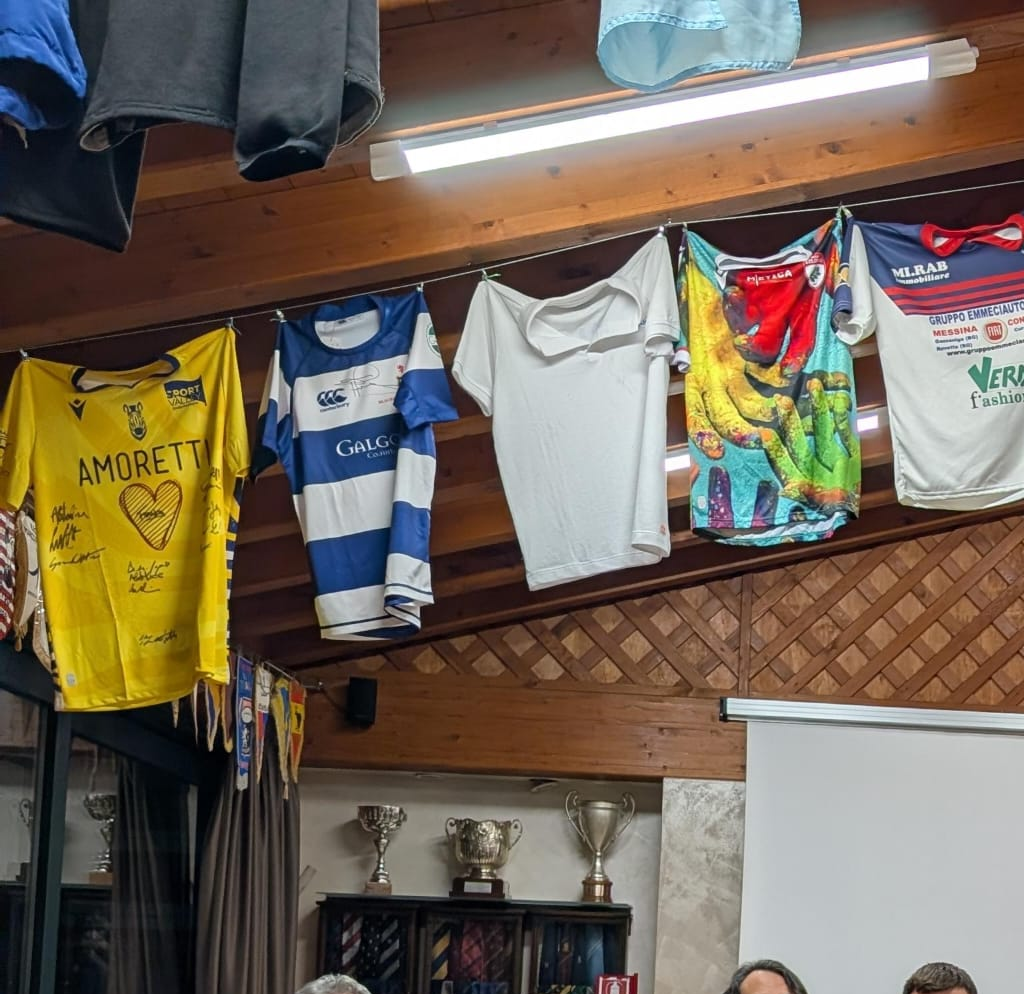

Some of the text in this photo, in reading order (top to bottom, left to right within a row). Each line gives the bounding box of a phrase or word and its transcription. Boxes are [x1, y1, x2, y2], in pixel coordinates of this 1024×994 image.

[929, 312, 966, 326] GRUPPO
[933, 325, 978, 337] MESSINA
[987, 325, 1002, 337] FIAT
